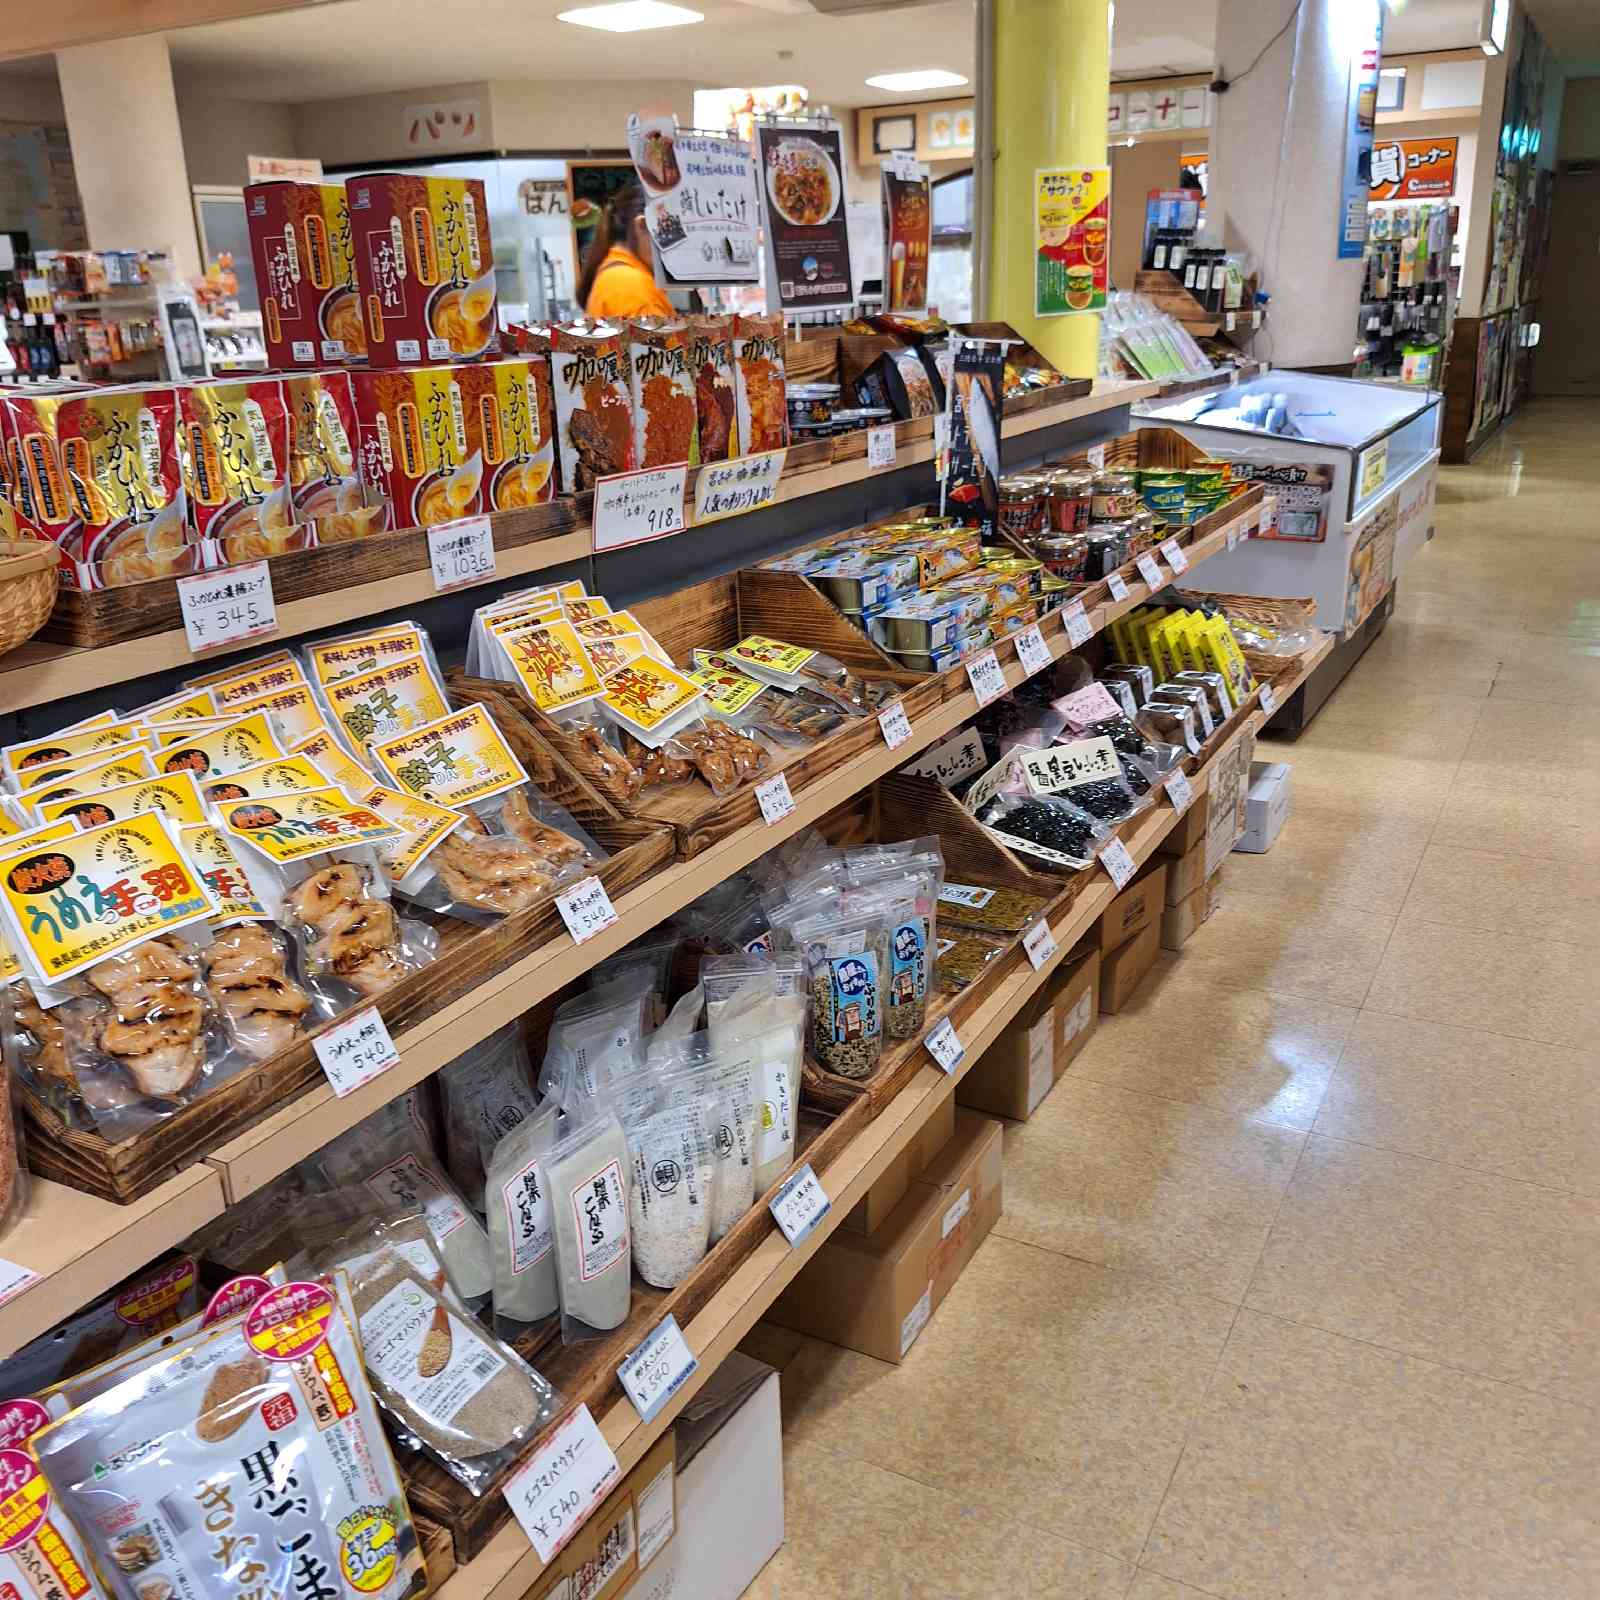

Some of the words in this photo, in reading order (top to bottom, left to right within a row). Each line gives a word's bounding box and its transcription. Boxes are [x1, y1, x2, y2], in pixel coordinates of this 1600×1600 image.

[1407, 147, 1452, 168] コーナー
[379, 240, 400, 308] ふかひれ
[442, 191, 468, 289] ふかひれ
[272, 245, 296, 311] ふかひれ
[214, 401, 265, 506] ふかひれ
[428, 382, 456, 478] ふかひれ
[508, 375, 530, 464] ふかひれ
[216, 602, 260, 630] 345
[24, 862, 192, 944] うめえ手羽
[352, 1041, 385, 1069] 540
[250, 1295, 326, 1333] プロテイン
[524, 1437, 585, 1510] エゴマパウダー
[194, 1479, 282, 1600] きな
